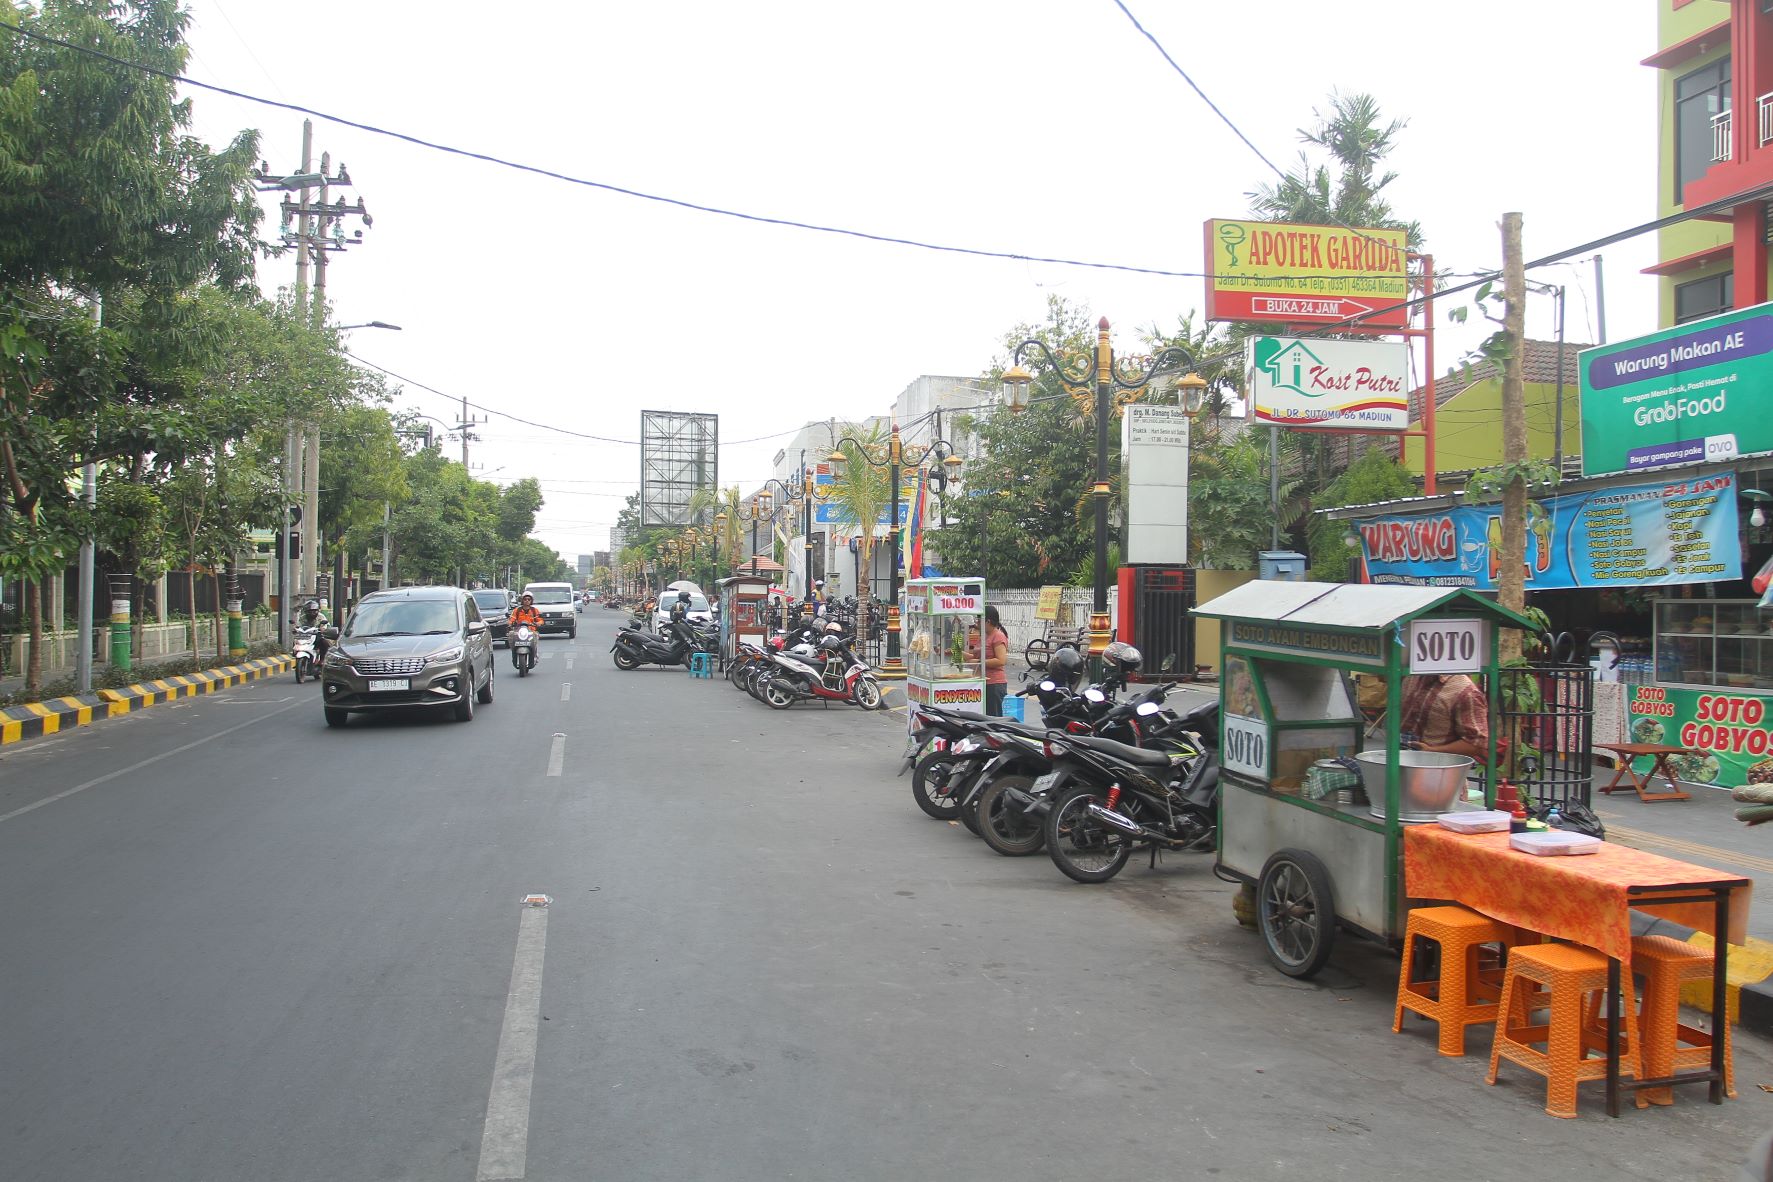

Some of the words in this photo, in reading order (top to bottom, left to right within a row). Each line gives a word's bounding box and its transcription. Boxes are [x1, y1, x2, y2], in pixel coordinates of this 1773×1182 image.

[1249, 230, 1322, 268] APOTEK
[1327, 236, 1401, 272] GARUDA
[1218, 272, 1239, 287] Jalan
[1241, 273, 1252, 287] Dr.
[1254, 274, 1283, 288] Sutomo
[1284, 275, 1296, 288] No.
[1298, 276, 1308, 289] 64
[1310, 276, 1327, 290] Telp.
[1328, 277, 1350, 292] (0351)
[1351, 278, 1377, 292] 463364
[1378, 278, 1404, 293] Madiun
[1267, 300, 1299, 312] BUKA
[1300, 302, 1313, 313] 24
[1316, 302, 1338, 314] JAM
[1614, 353, 1669, 376] Warung
[1670, 339, 1721, 363] Makan
[1724, 331, 1744, 351] AE
[1310, 365, 1351, 390] Kost
[1355, 367, 1402, 392] Putri
[1622, 392, 1650, 404] Beragam
[1650, 389, 1668, 398] Menu
[1669, 385, 1687, 395] Enak,
[1688, 380, 1705, 391] Pasti
[1705, 377, 1728, 387] Hemat
[1729, 374, 1737, 382] di
[1271, 408, 1283, 418] JL.
[1287, 408, 1302, 418] DR.
[1305, 409, 1342, 419] SUTOMO
[1344, 411, 1356, 420] 66
[1359, 412, 1392, 421] MADIUN
[1634, 389, 1725, 427] GrabFood
[1630, 454, 1650, 464] Bayar
[1650, 450, 1684, 463] gampang
[1684, 447, 1702, 459] pake
[1594, 492, 1662, 506] PRASMANAN
[1662, 483, 1687, 498] 24
[1691, 476, 1731, 494] JAM
[1668, 496, 1717, 509] Gorengan
[1671, 508, 1710, 520] Jajanan
[1588, 519, 1606, 528] Nasi
[1672, 521, 1693, 531] Kopi
[1360, 516, 1457, 563] WARUNG
[1589, 529, 1607, 538] Nasi
[1608, 528, 1632, 538] Sayur
[1591, 539, 1609, 548] Nasi
[1593, 550, 1610, 558] Nasi
[1612, 548, 1647, 558] Campur
[1677, 555, 1687, 563] Es
[1594, 560, 1612, 569] Soto
[1614, 558, 1645, 568] Gobyos
[1678, 565, 1687, 574] Es
[1688, 563, 1725, 574] Campur
[1595, 570, 1609, 579] Mie
[1612, 568, 1669, 579] Goreng/kuah
[941, 597, 975, 609] 10.000
[1235, 624, 1265, 642] SOTO
[1267, 626, 1300, 646] AYAM
[1303, 631, 1378, 656] EMBONGAN
[1416, 630, 1475, 662] SOTO
[934, 688, 981, 704] PENYETAN
[1637, 687, 1665, 701] SOTO
[1630, 701, 1674, 716] GOBYOS
[1696, 694, 1765, 726] SOTO
[1227, 727, 1264, 769] SOTO
